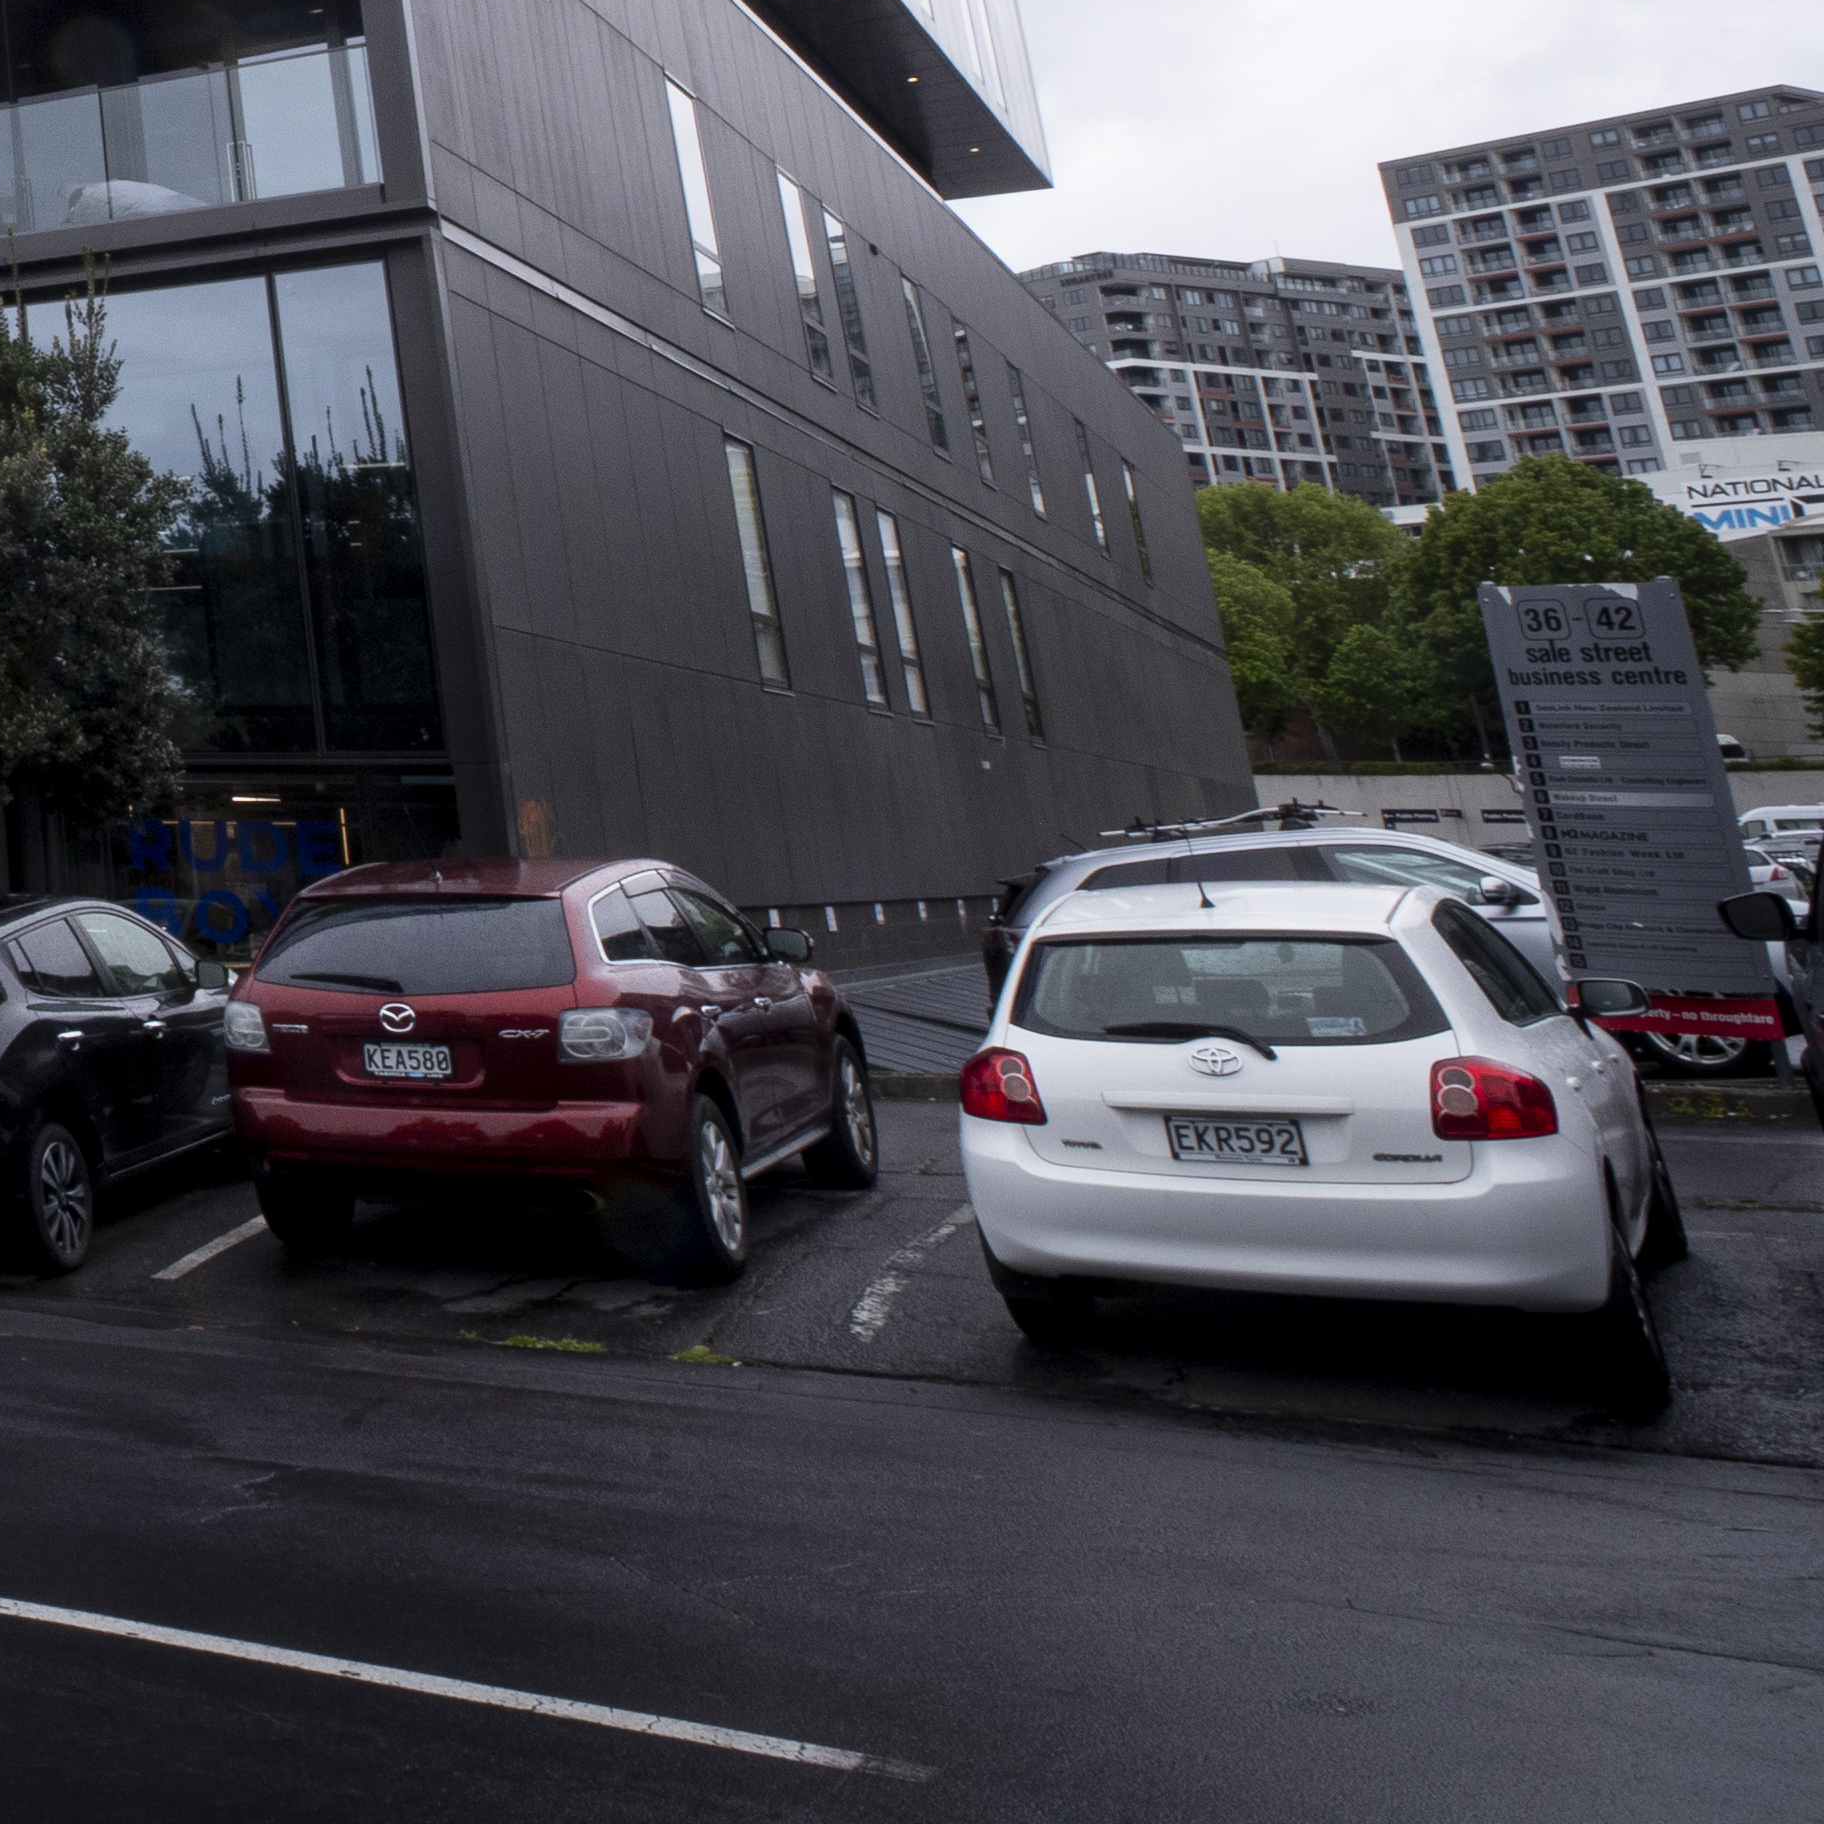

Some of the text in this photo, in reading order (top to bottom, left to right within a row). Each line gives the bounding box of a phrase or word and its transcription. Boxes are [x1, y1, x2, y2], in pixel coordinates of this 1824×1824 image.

[1687, 474, 1824, 499] NATIONAL
[1693, 505, 1792, 530] MINI
[1523, 607, 1563, 633] 36
[1595, 606, 1637, 631] 42
[1525, 640, 1653, 664] sale street
[1508, 665, 1688, 686] business centre
[129, 818, 341, 877] RUDE
[1681, 1011, 1698, 1021] no
[366, 1047, 450, 1072] KEA580
[1172, 1123, 1300, 1156] EKR592
